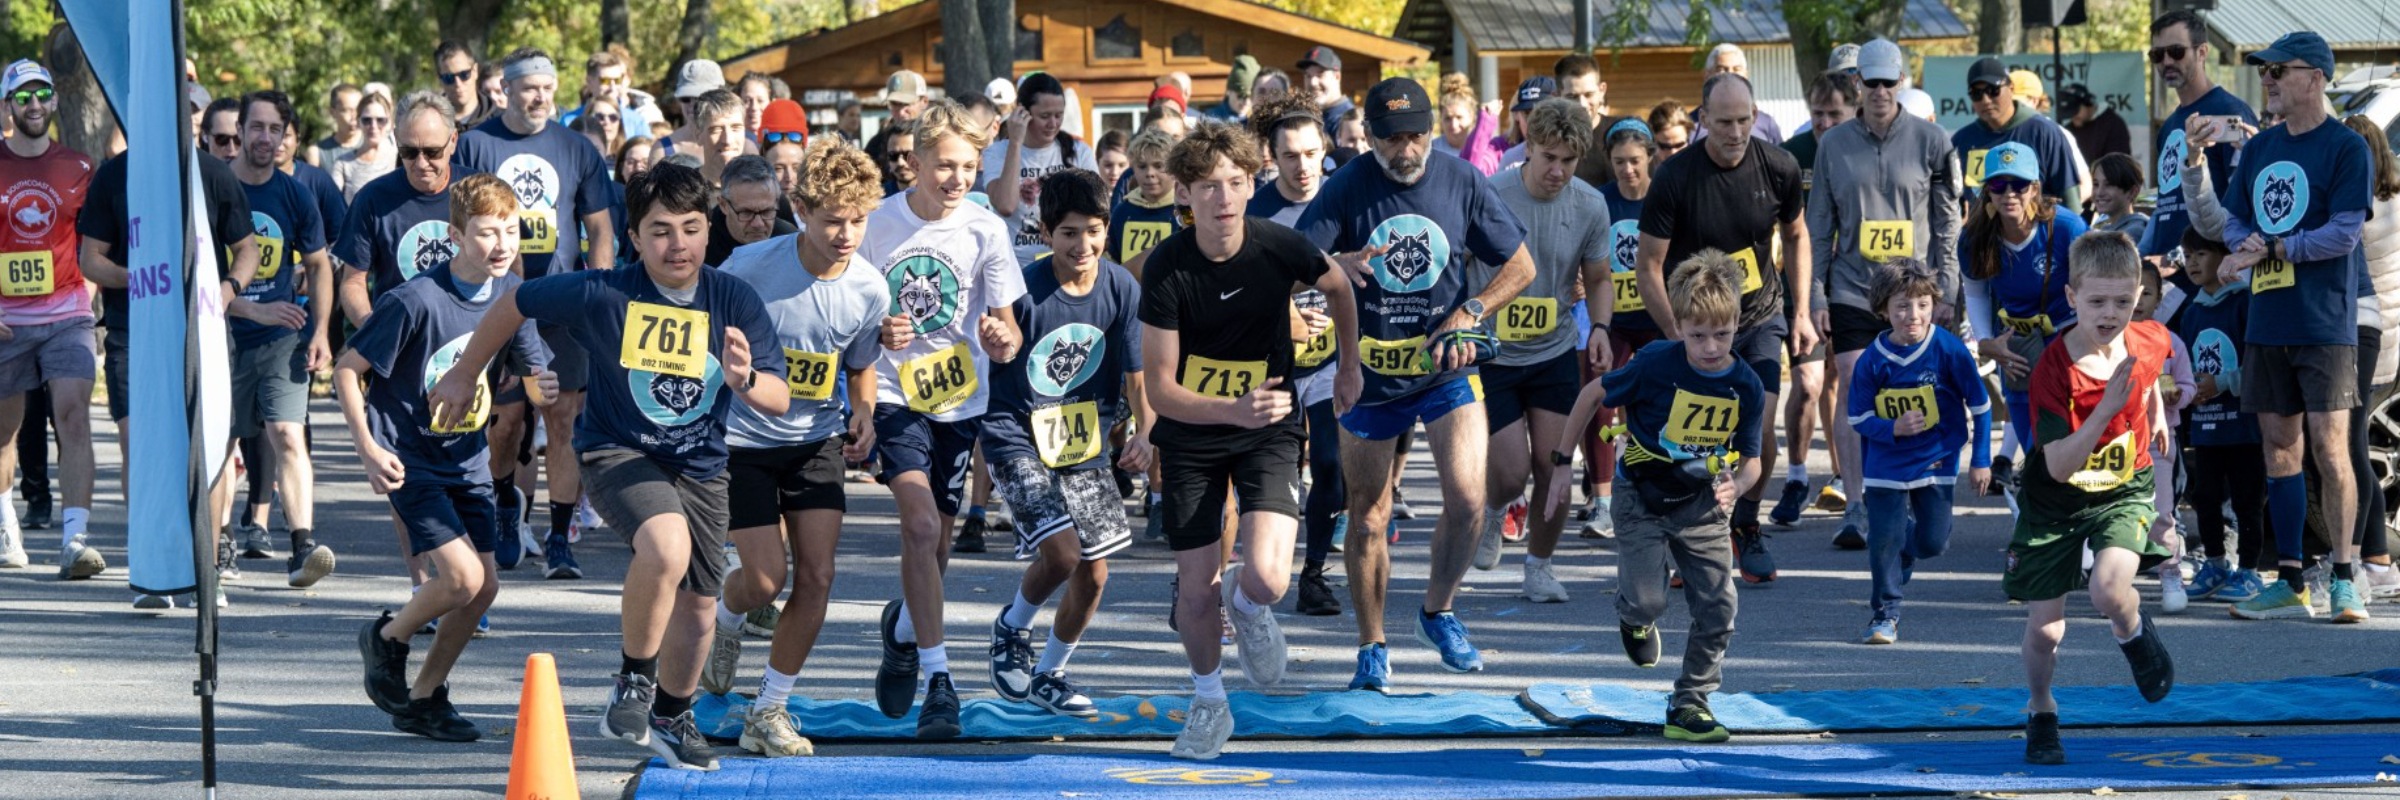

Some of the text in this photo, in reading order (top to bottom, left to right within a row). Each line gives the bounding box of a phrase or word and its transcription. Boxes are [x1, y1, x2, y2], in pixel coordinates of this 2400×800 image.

[1015, 234, 1044, 246] COM
[1870, 228, 1904, 250] 754
[9, 259, 45, 283] 695
[1615, 278, 1638, 300] 75
[1508, 304, 1547, 329] 620
[638, 314, 692, 356] 761
[641, 358, 686, 372] 802 TIMING
[1370, 347, 1416, 370] 597
[914, 355, 966, 400] 648
[1197, 366, 1252, 398] 713
[1682, 403, 1733, 432] 711
[1044, 413, 1089, 449] 744
[948, 450, 970, 489] 2
